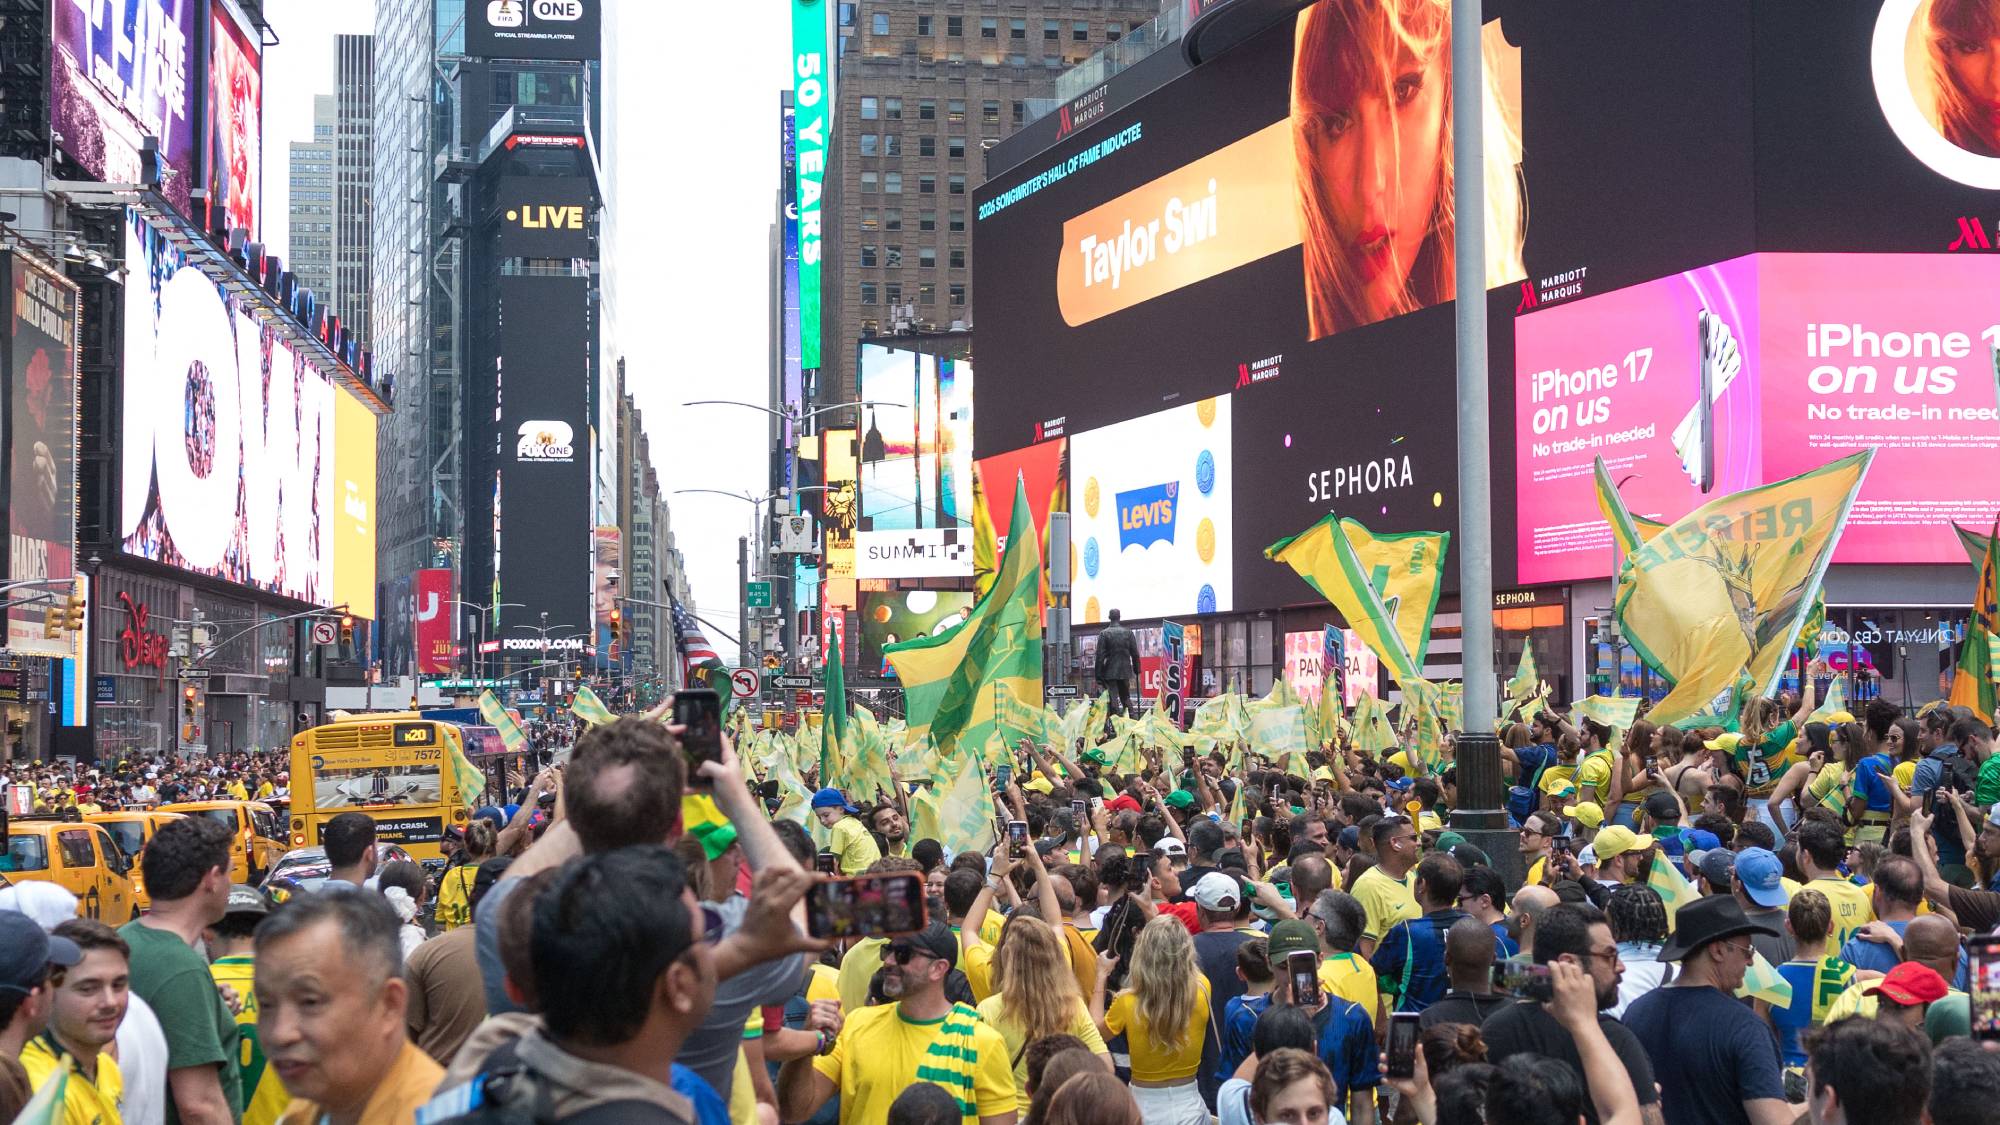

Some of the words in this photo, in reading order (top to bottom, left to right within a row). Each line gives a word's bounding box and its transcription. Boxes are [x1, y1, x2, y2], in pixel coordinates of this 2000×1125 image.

[539, 2, 576, 16] ONE
[797, 52, 822, 108] 50
[1074, 84, 1108, 112] MARRIOTT
[1074, 101, 1104, 126] MARQUIS
[979, 199, 995, 220] 2026
[995, 171, 1047, 212] SONGWRITER'S
[1048, 162, 1067, 185] HALL
[1067, 155, 1079, 174] OF
[1079, 143, 1101, 169] FAME
[1101, 121, 1142, 158] INDUCTEE
[799, 115, 824, 266] YEARS
[522, 206, 583, 229] LIVE
[1080, 216, 1160, 290] Taylor
[1164, 176, 1217, 255] Swi
[1541, 266, 1587, 289] MARRIOTT
[1541, 283, 1582, 303] MARQUIS
[15, 288, 40, 328] WORLD
[41, 305, 63, 342] COULD
[1807, 323, 1971, 358] iPhone
[1981, 324, 2000, 349] 1
[1252, 354, 1282, 370] MARRIOTT
[1252, 367, 1279, 382] MARQUIS
[1531, 363, 1618, 403] iPhone
[1623, 347, 1653, 383] 17
[1807, 365, 1878, 394] on
[1893, 365, 1958, 395] us
[1044, 416, 1066, 429] MARRIOTT
[1532, 404, 1568, 434] on
[1576, 396, 1611, 427] us
[1807, 403, 1842, 420] No
[1846, 403, 1942, 420] trade-in
[1044, 427, 1064, 438] MARQUIS
[1532, 443, 1551, 458] No
[1552, 433, 1603, 454] trade-in
[1605, 422, 1655, 446] needed
[549, 446, 569, 455] ONE
[1308, 455, 1413, 502] SEPHORA
[868, 543, 948, 560] SUMMIT
[1495, 592, 1536, 605] SEPHORA
[120, 591, 169, 693] Disney
[1300, 655, 1361, 678] PANRA
[414, 749, 441, 760] 7572
[1747, 749, 1771, 784] 5
[376, 832, 405, 840] TRIANS.
[400, 822, 429, 830] CRASH.
